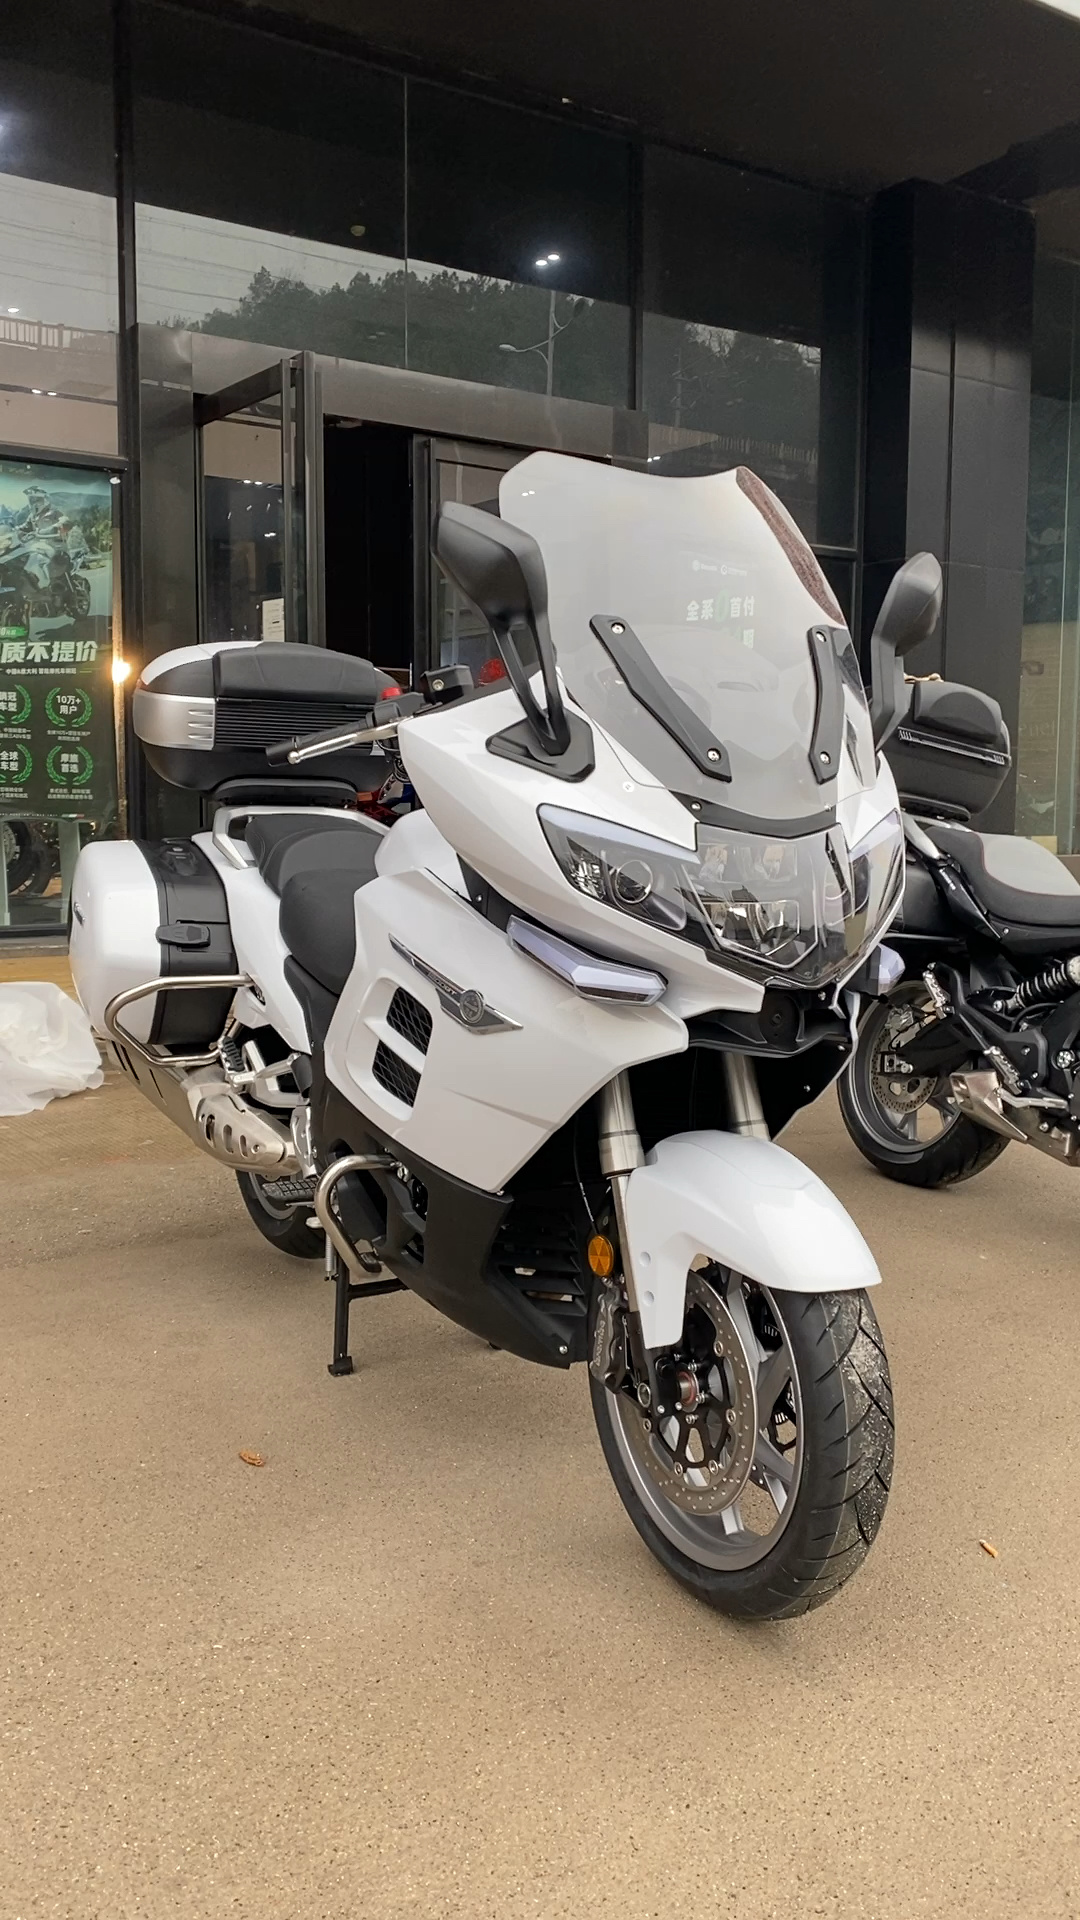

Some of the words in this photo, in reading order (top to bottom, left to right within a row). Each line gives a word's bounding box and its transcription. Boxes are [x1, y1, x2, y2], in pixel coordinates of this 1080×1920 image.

[0, 640, 98, 663] 质不提价
[56, 695, 81, 705] 10万+
[59, 705, 78, 715] 用户
[0, 750, 19, 760] 全球
[0, 761, 19, 771] 车型
[594, 1320, 606, 1367] brembo
